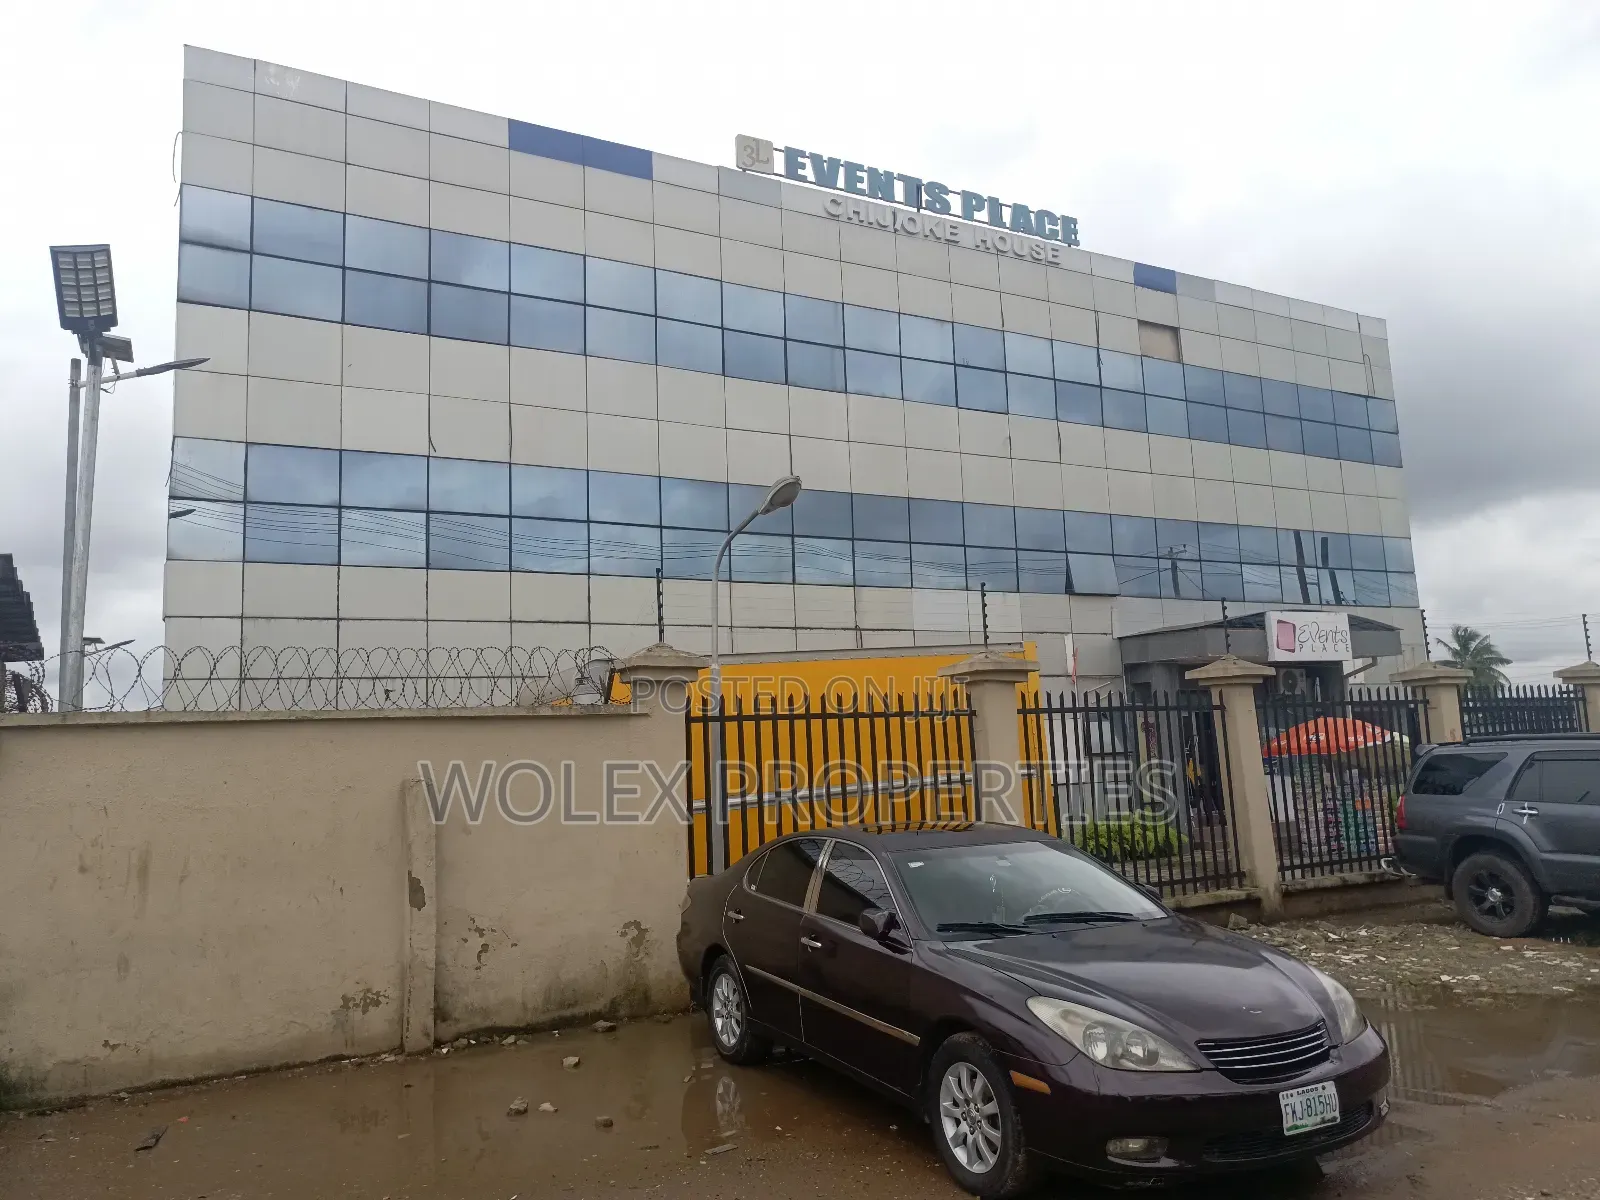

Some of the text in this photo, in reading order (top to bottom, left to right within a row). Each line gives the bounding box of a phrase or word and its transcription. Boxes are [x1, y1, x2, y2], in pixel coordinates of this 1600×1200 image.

[784, 146, 951, 215] EVENTS
[960, 189, 1080, 247] PLACE
[974, 226, 1061, 265] HOUSE
[1299, 643, 1349, 652] PLACE
[1296, 1087, 1319, 1096] LAGOS
